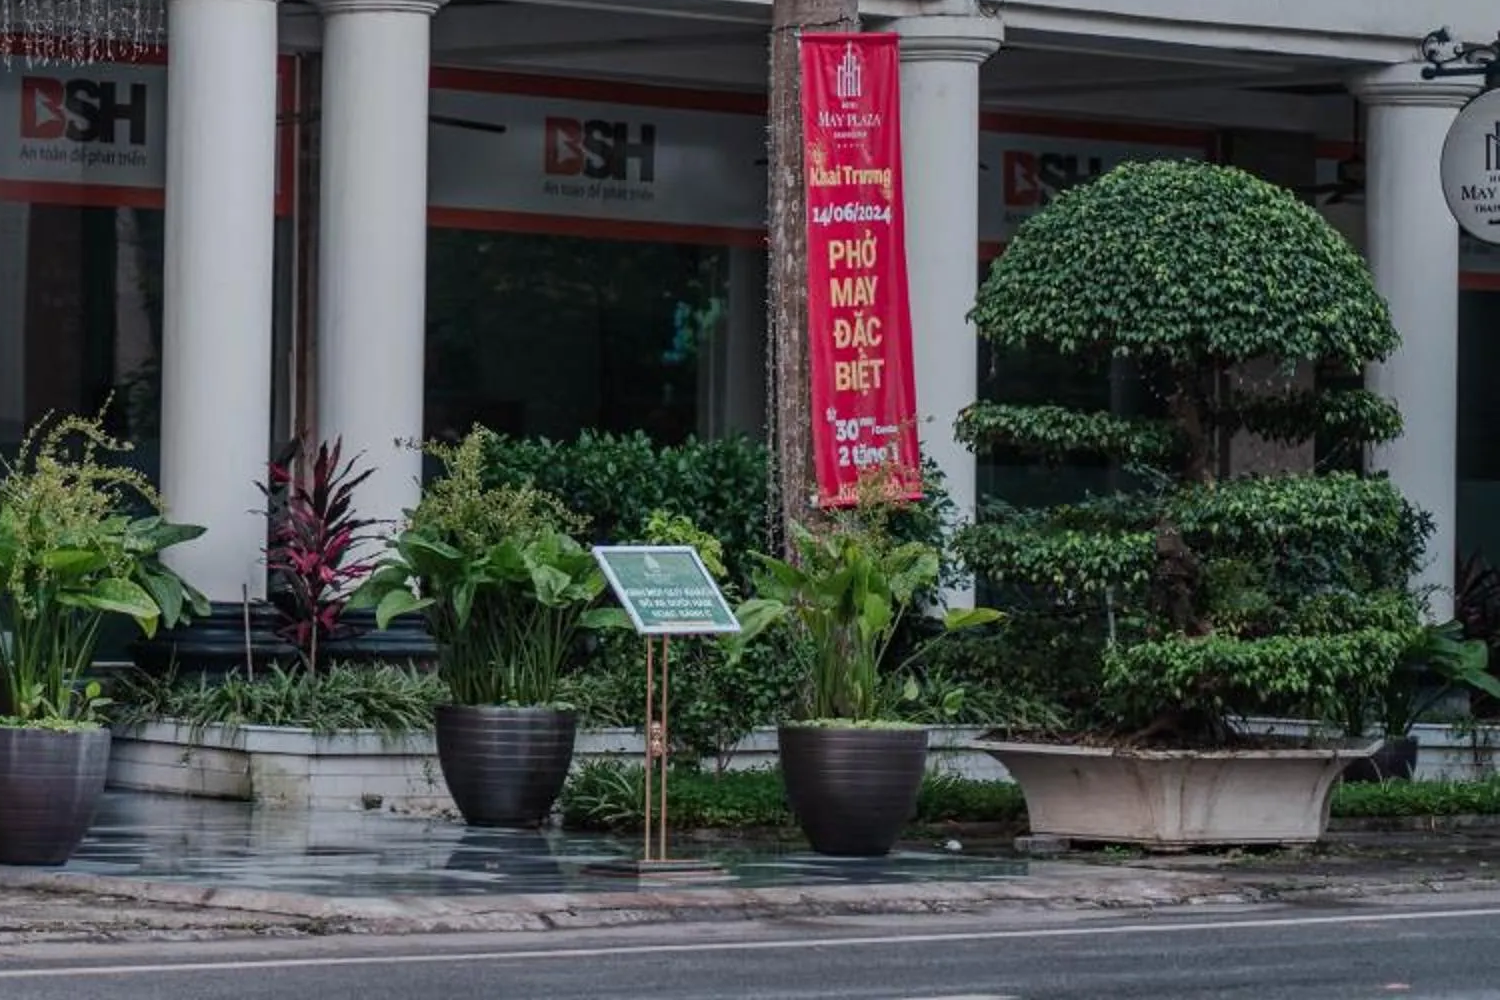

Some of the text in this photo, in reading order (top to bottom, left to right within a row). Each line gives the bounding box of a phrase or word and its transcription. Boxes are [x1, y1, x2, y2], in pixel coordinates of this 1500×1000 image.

[21, 76, 147, 145] BSH
[545, 116, 656, 183] BSH
[1461, 184, 1497, 200] MAY
[812, 201, 892, 226] 14/06/2024
[828, 229, 878, 270] PHỞ
[829, 276, 878, 308] MAY
[833, 311, 883, 353] ĐẶC
[835, 353, 885, 396] BIỆT
[835, 419, 859, 441] 30
[838, 445, 850, 467] 2
